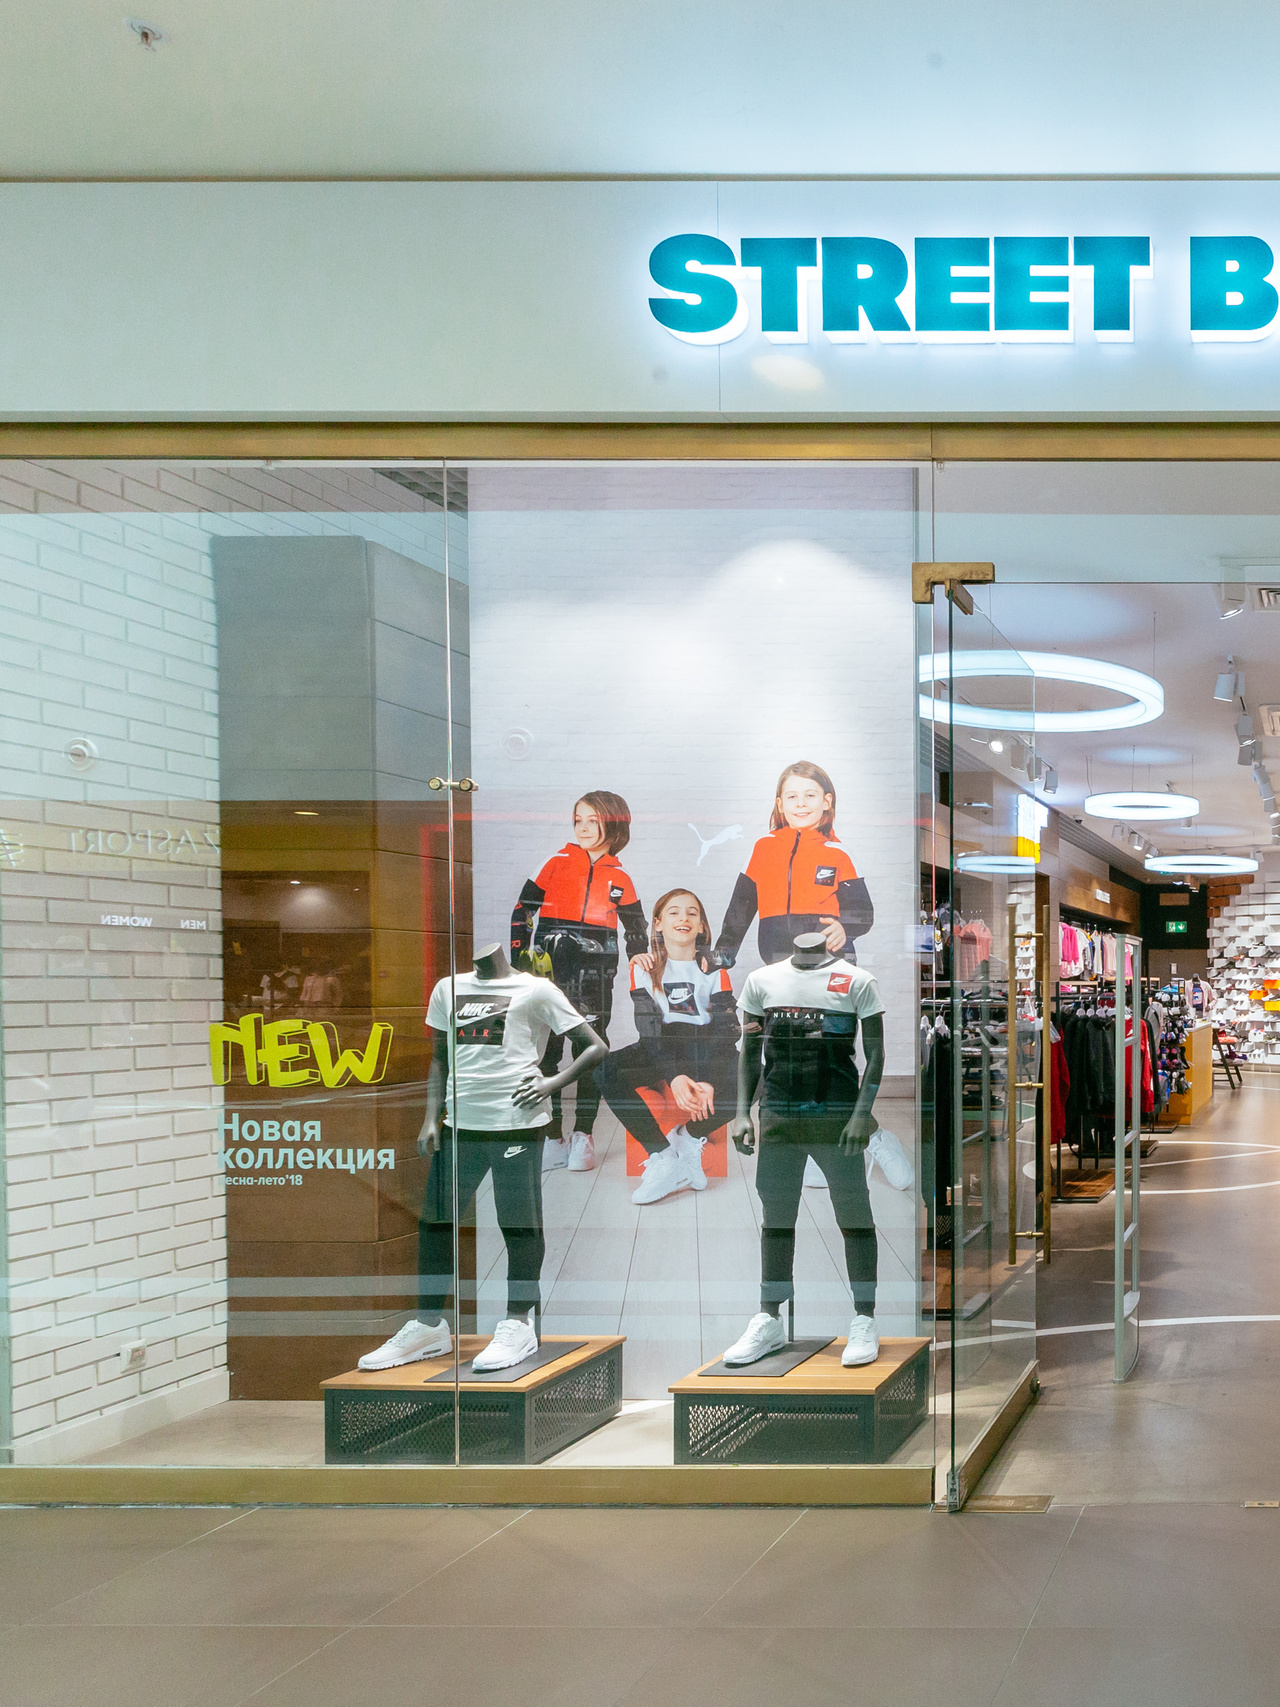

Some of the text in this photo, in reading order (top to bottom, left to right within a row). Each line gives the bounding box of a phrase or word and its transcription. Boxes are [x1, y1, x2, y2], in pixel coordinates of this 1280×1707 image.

[648, 233, 1152, 338] STREET
[457, 1003, 496, 1017] NIKE
[458, 1029, 489, 1037] AIR
[208, 1012, 394, 1089] NEW
[217, 1113, 322, 1142] Новая
[217, 1147, 395, 1175] коллекция
